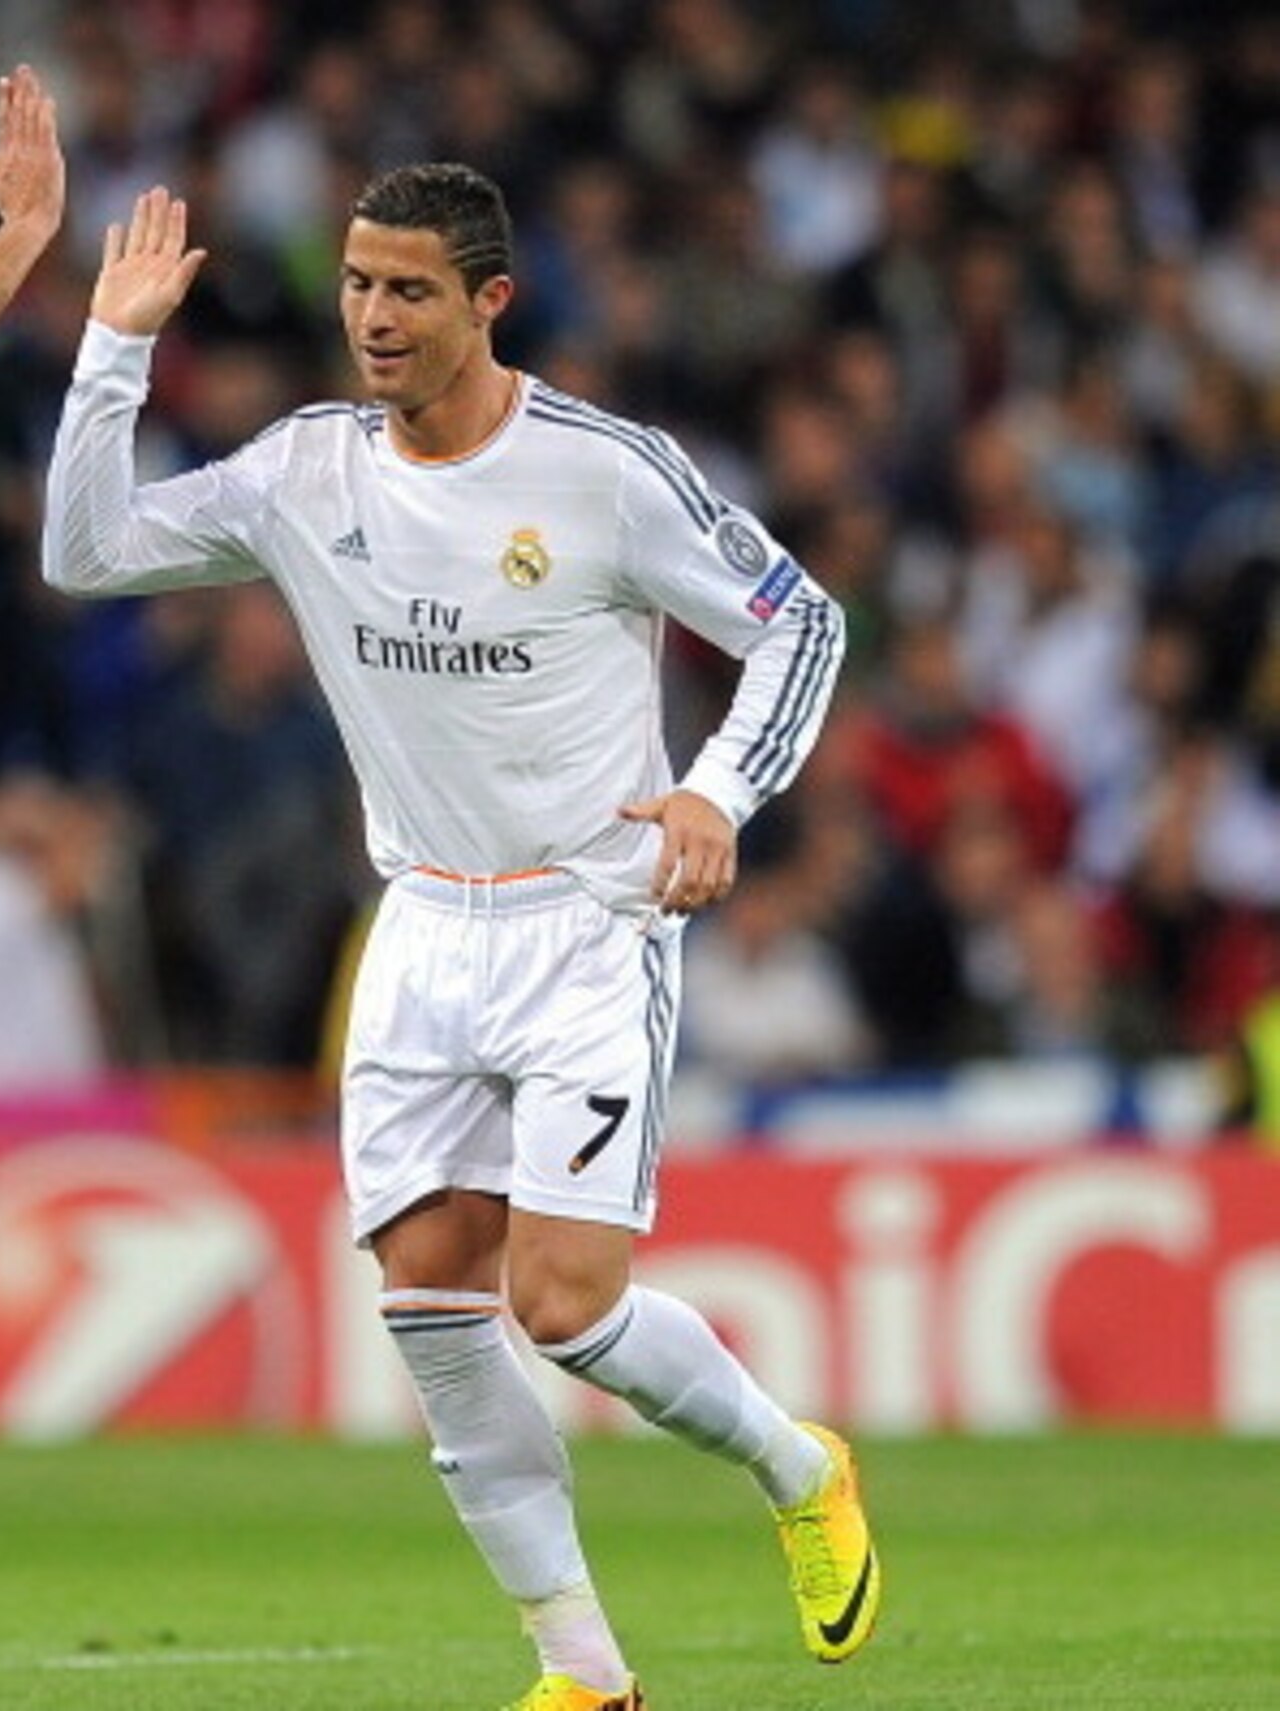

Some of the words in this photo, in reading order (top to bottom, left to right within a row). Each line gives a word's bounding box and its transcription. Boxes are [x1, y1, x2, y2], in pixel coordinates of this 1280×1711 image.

[408, 599, 462, 634] Fly
[354, 624, 532, 674] Emirates
[568, 1094, 630, 1176] 7
